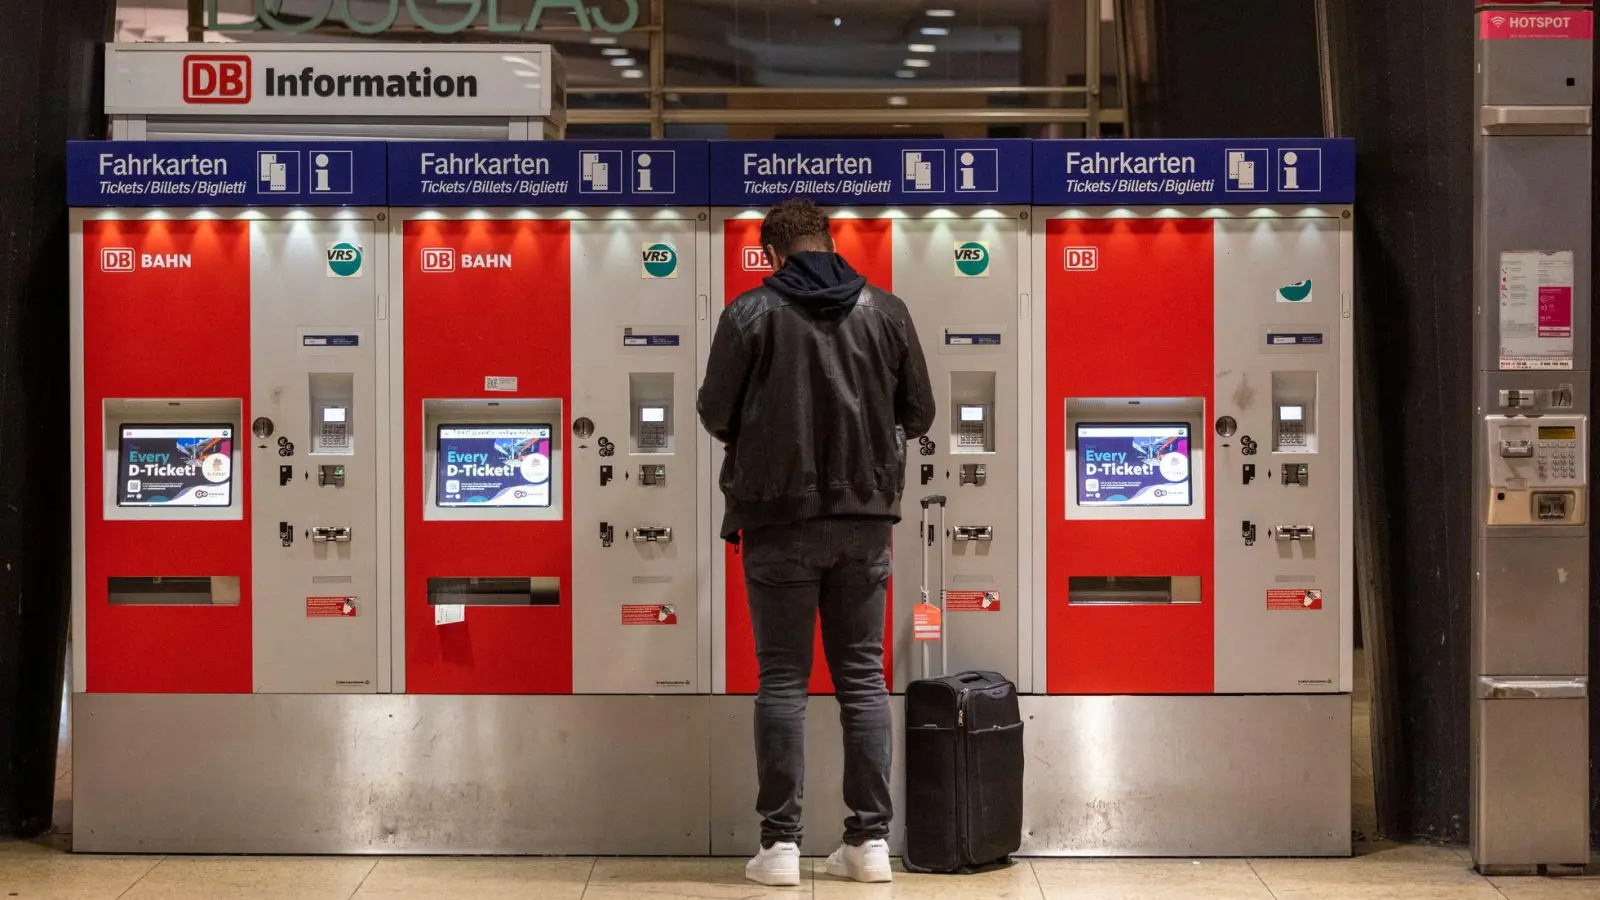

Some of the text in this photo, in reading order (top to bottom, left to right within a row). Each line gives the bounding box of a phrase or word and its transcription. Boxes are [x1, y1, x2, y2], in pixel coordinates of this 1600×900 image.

[1509, 17, 1571, 28] HOTSPOT
[191, 63, 478, 98] DB Information
[99, 153, 228, 176] Fahrkarten
[421, 152, 550, 175] Fahrkarten
[743, 153, 872, 175] Fahrkarten
[1066, 151, 1195, 174] Fahrkarten
[106, 252, 192, 268] DB BAHN
[327, 250, 354, 261] VRS
[426, 252, 512, 268] DB BAHN
[642, 251, 668, 262] VRS
[954, 249, 980, 260] VRS
[1068, 251, 1094, 266] DB
[129, 451, 170, 465] Every
[447, 451, 488, 465] Every
[1085, 450, 1127, 464] Every
[128, 464, 196, 476] D-Ticket!
[447, 464, 515, 476] D-Ticket!
[1086, 463, 1154, 475] D-Ticket!
